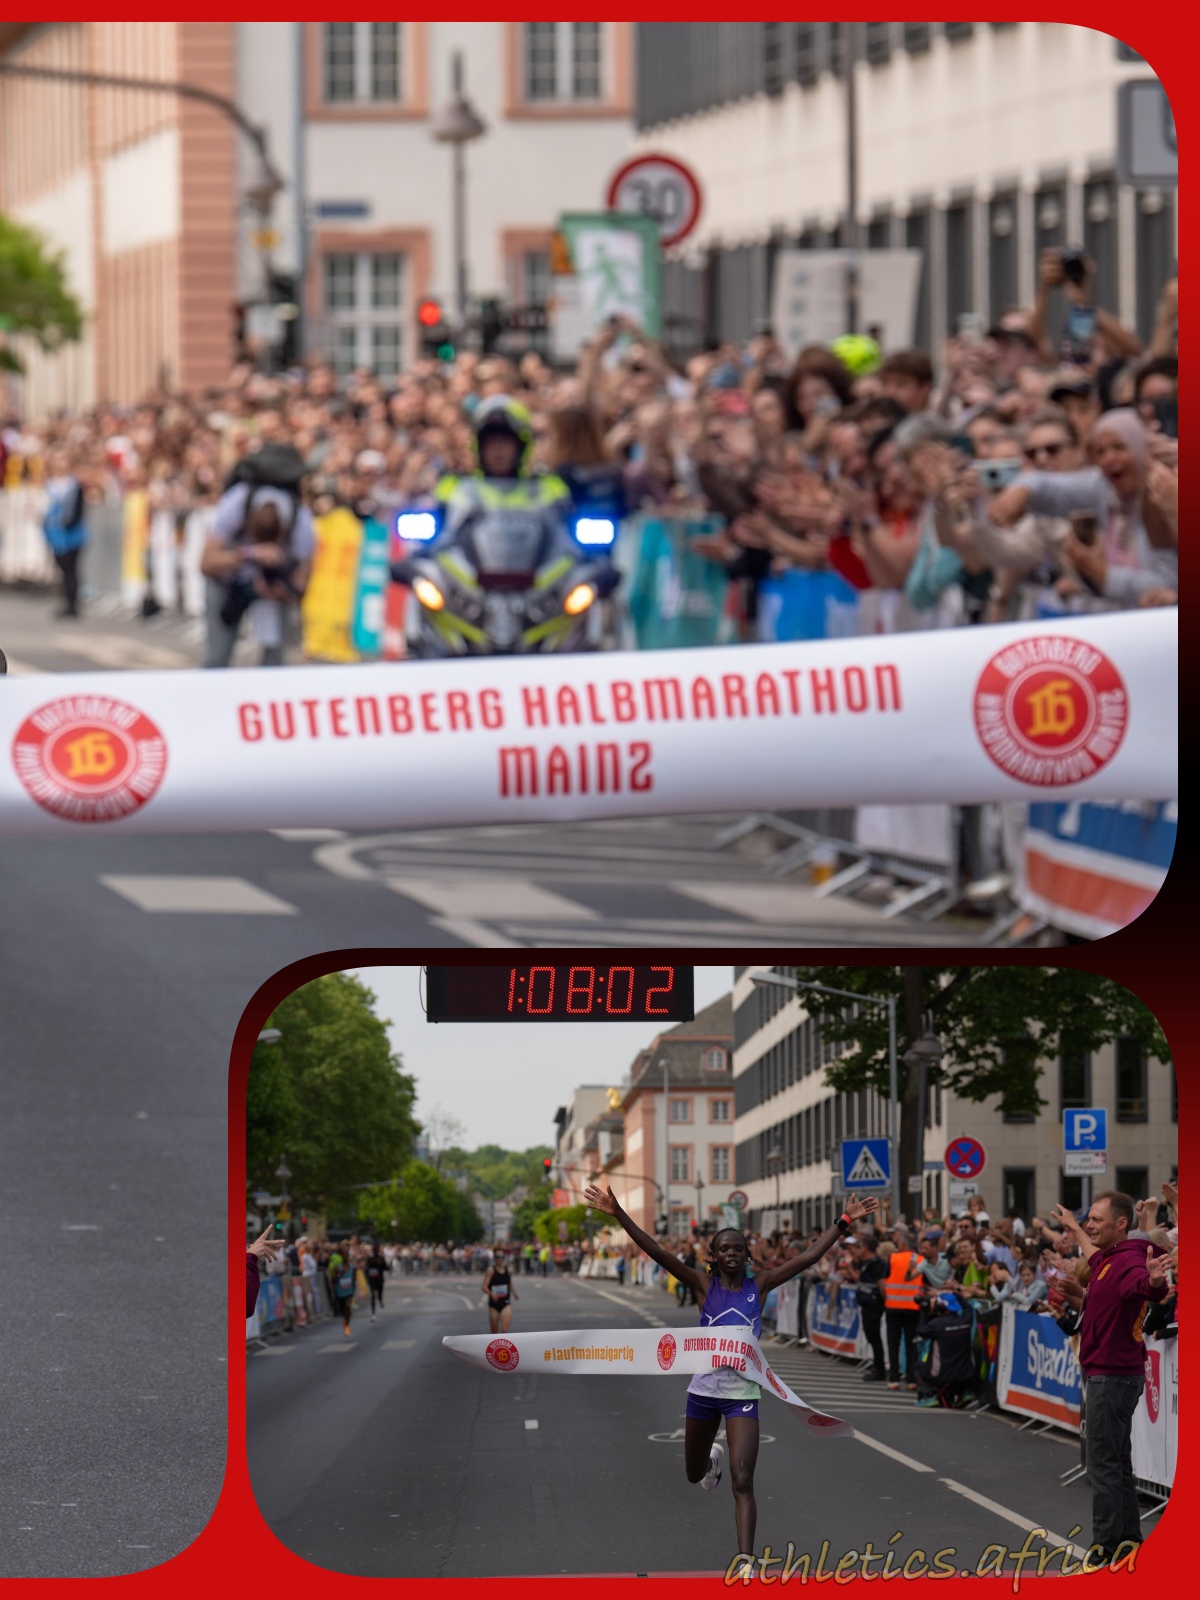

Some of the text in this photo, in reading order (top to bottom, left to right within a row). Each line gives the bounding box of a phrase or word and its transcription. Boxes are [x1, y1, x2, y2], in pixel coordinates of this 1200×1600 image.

[992, 639, 1103, 679] GUTENBERG
[237, 663, 904, 742] GUTENBERG HALBMARATHON
[497, 741, 654, 799] MAINZ
[507, 966, 674, 1014] 1:08:02
[1073, 1113, 1097, 1146] P
[543, 1345, 635, 1361] #laufmainzigartig
[683, 1338, 717, 1352] GUTENBERG
[711, 1354, 747, 1372] MAINZ
